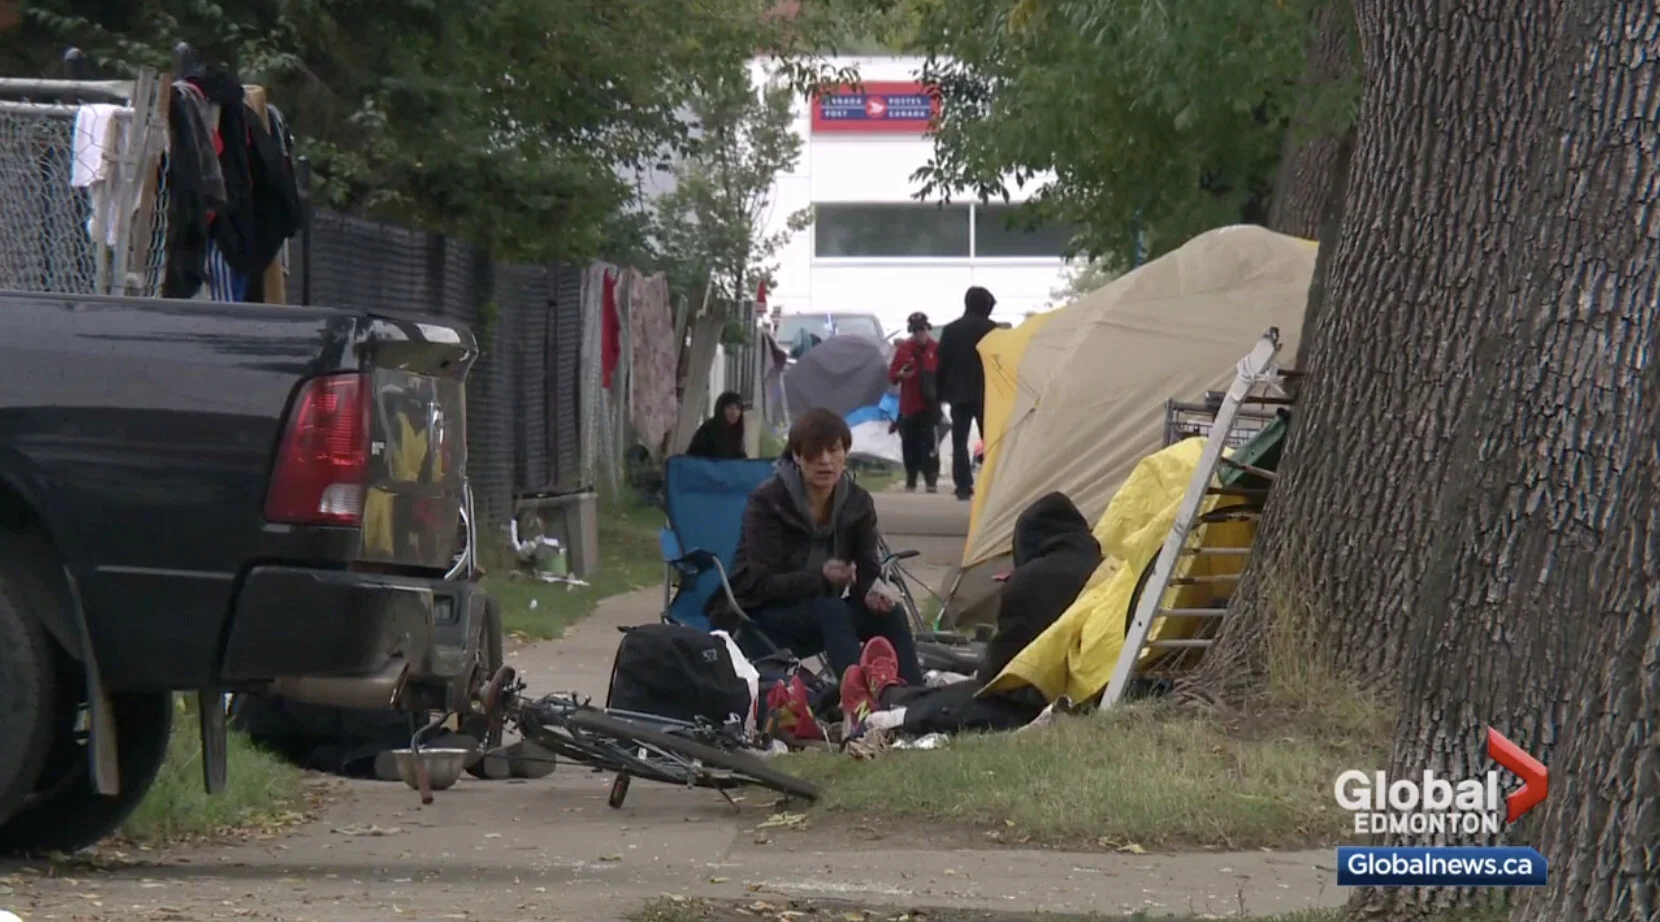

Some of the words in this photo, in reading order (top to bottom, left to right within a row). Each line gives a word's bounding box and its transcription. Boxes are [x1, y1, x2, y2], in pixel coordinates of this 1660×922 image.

[888, 97, 922, 105] POSTES
[825, 110, 848, 118] POST
[888, 110, 926, 118] CANADA
